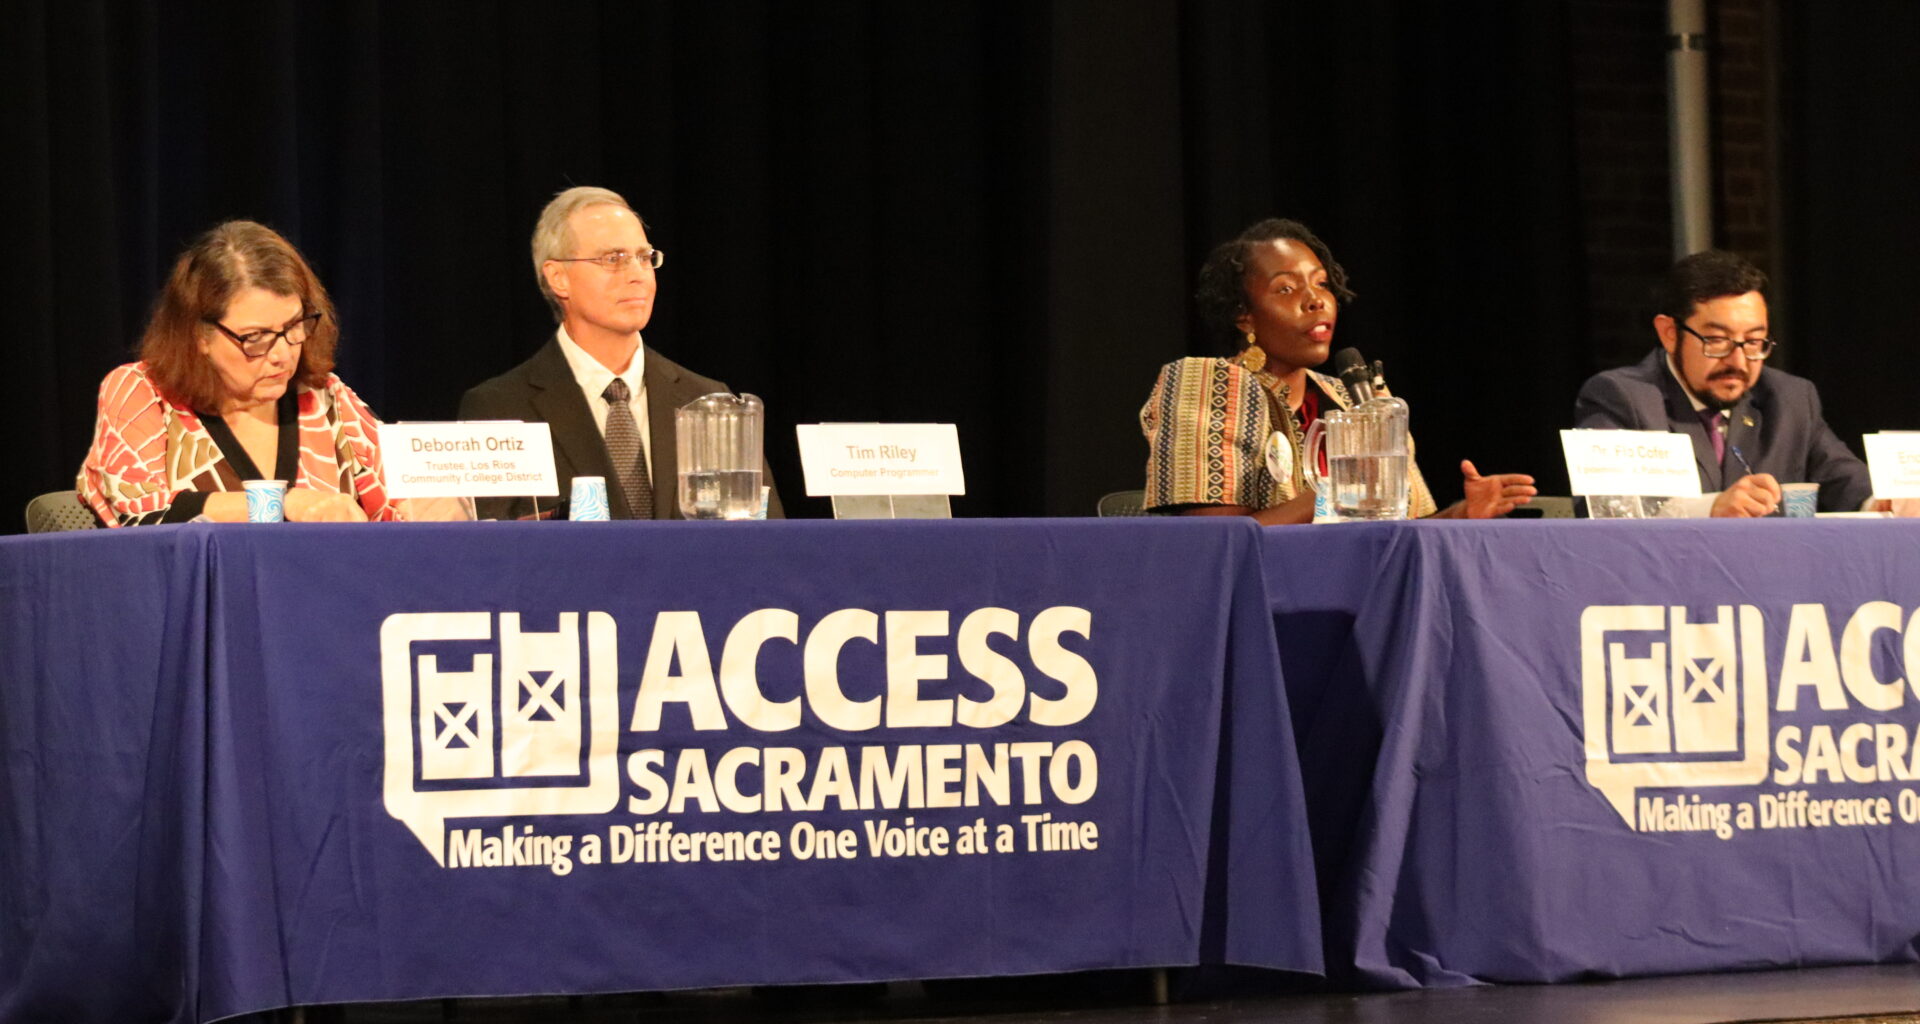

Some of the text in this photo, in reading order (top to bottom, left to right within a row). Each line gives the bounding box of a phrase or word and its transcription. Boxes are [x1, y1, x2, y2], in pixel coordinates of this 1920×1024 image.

[411, 437, 525, 452] Deborah Ortiz
[845, 445, 917, 462] Tim Riley
[402, 472, 543, 484] Community College District
[471, 460, 489, 470] Los
[492, 460, 516, 469] Rios
[830, 467, 939, 479] Computer Programmer
[630, 605, 1098, 732] ACCESS
[1775, 600, 1920, 711] AC
[626, 740, 1098, 815] SACRAMENTO
[1638, 788, 1920, 840] Making a Difference O
[448, 812, 1099, 876] Making a Difference One Voice at a Time
